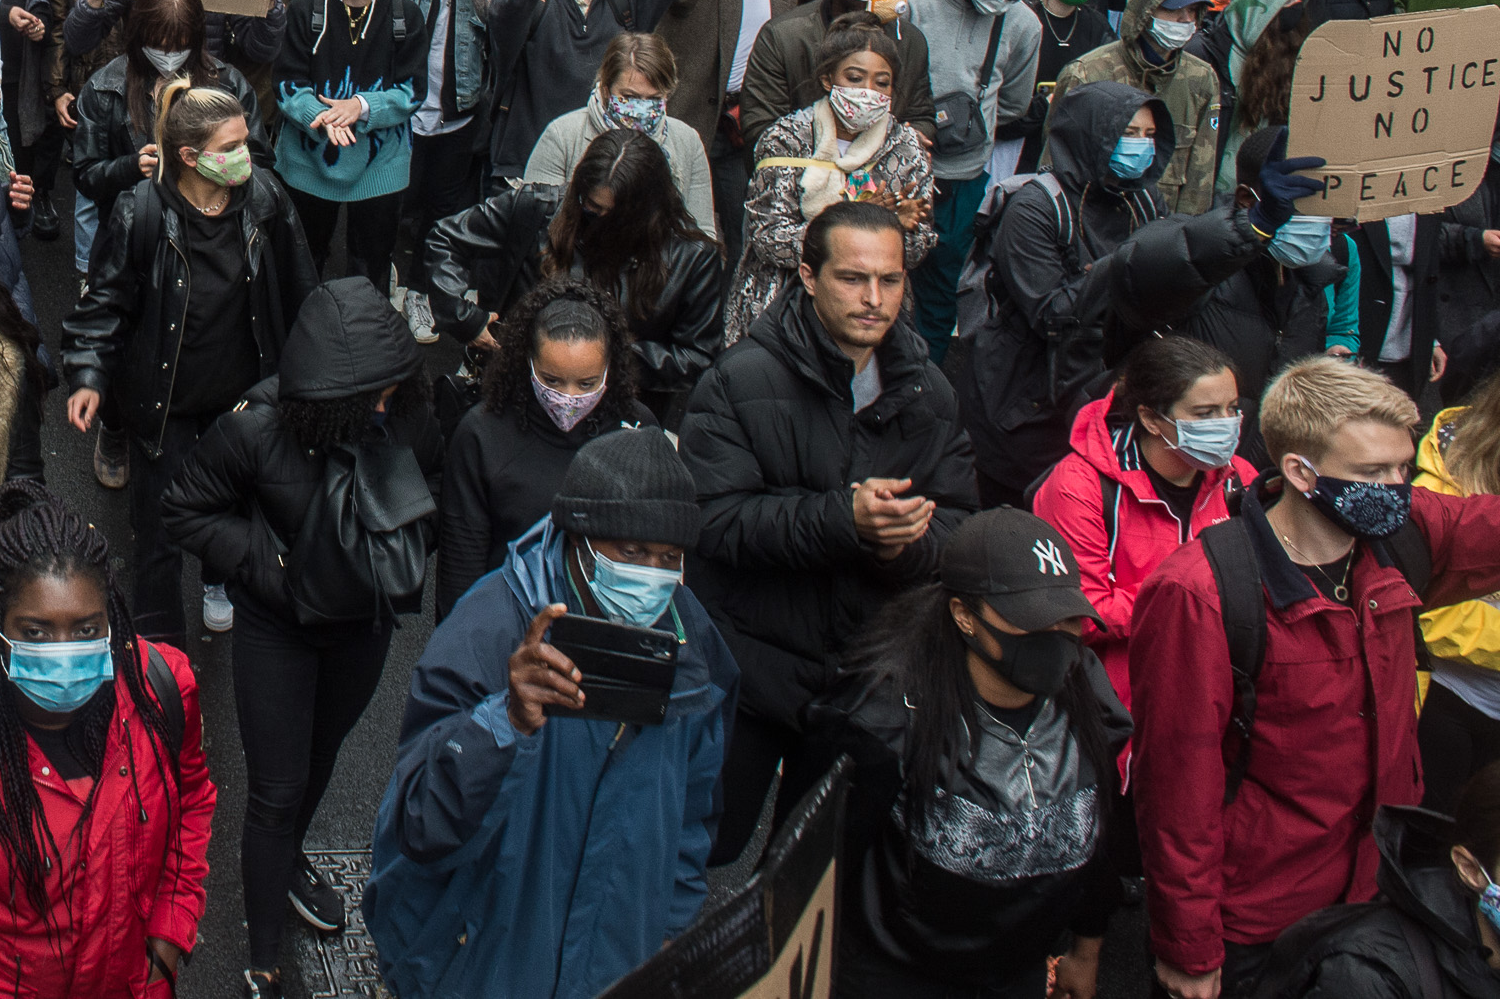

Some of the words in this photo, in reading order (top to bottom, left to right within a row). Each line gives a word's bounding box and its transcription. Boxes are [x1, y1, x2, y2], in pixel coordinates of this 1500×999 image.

[1382, 26, 1435, 59] NO
[1309, 58, 1499, 102] JUSTICE
[1374, 107, 1430, 140] NO
[1322, 159, 1468, 201] PEACE
